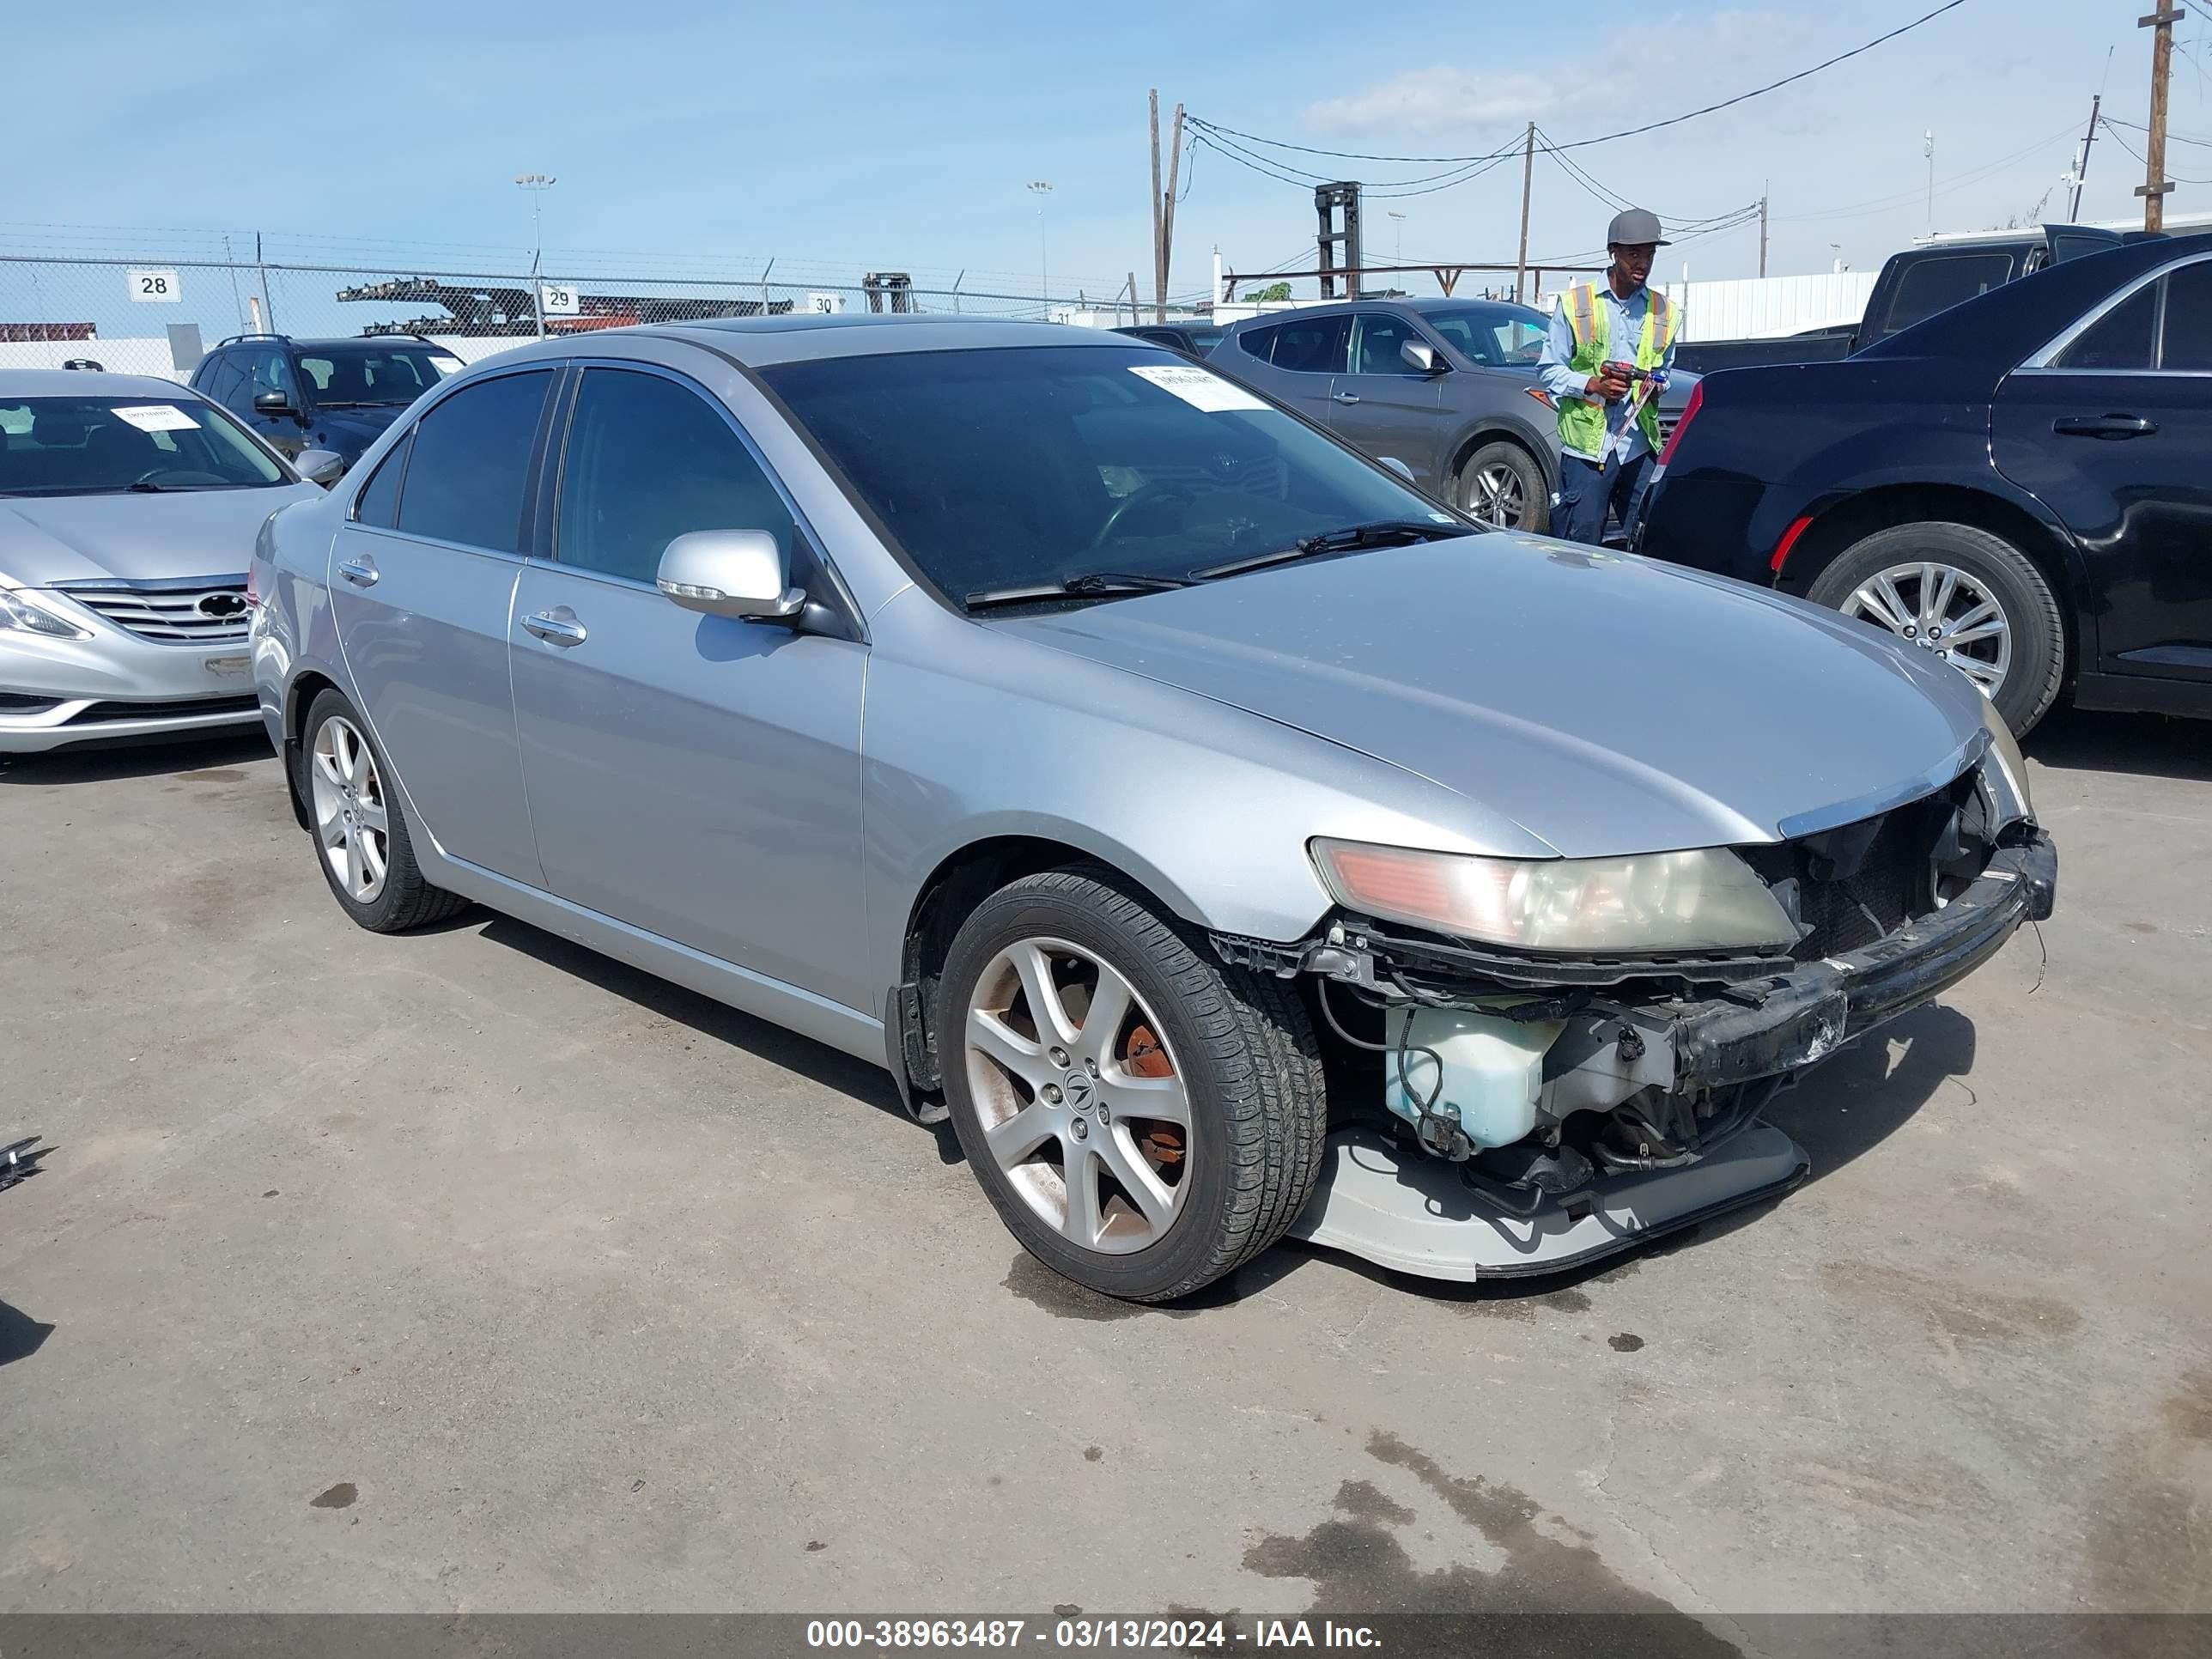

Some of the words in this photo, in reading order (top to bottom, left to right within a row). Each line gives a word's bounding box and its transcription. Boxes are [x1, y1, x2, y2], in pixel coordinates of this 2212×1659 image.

[142, 277, 167, 294] 28
[550, 292, 568, 306] 29
[817, 298, 831, 311] 30
[1058, 313, 1069, 325] 31
